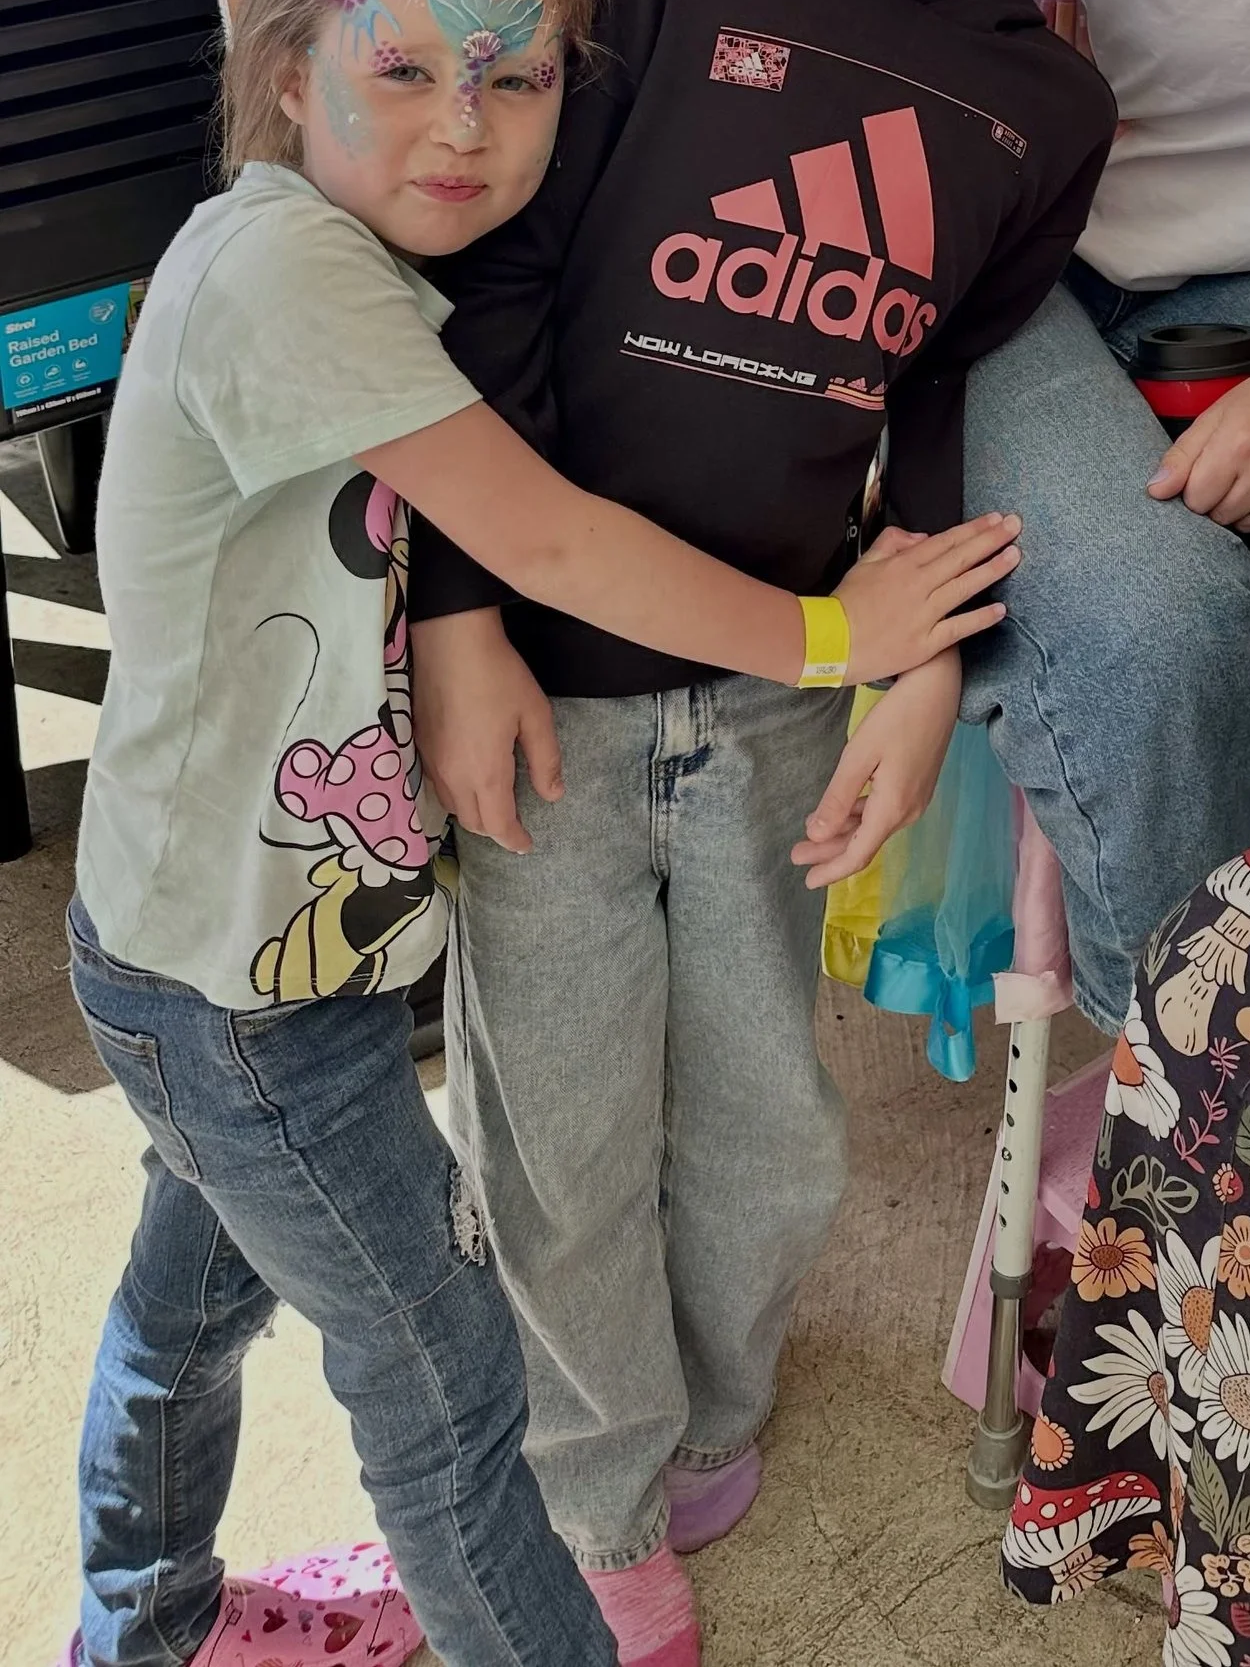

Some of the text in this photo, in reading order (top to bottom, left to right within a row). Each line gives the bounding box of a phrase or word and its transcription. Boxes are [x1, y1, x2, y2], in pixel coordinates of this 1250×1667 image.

[650, 232, 937, 358] adidas
[8, 330, 60, 354] Raised
[9, 333, 98, 368] Garden Bed
[623, 331, 681, 355] NOW
